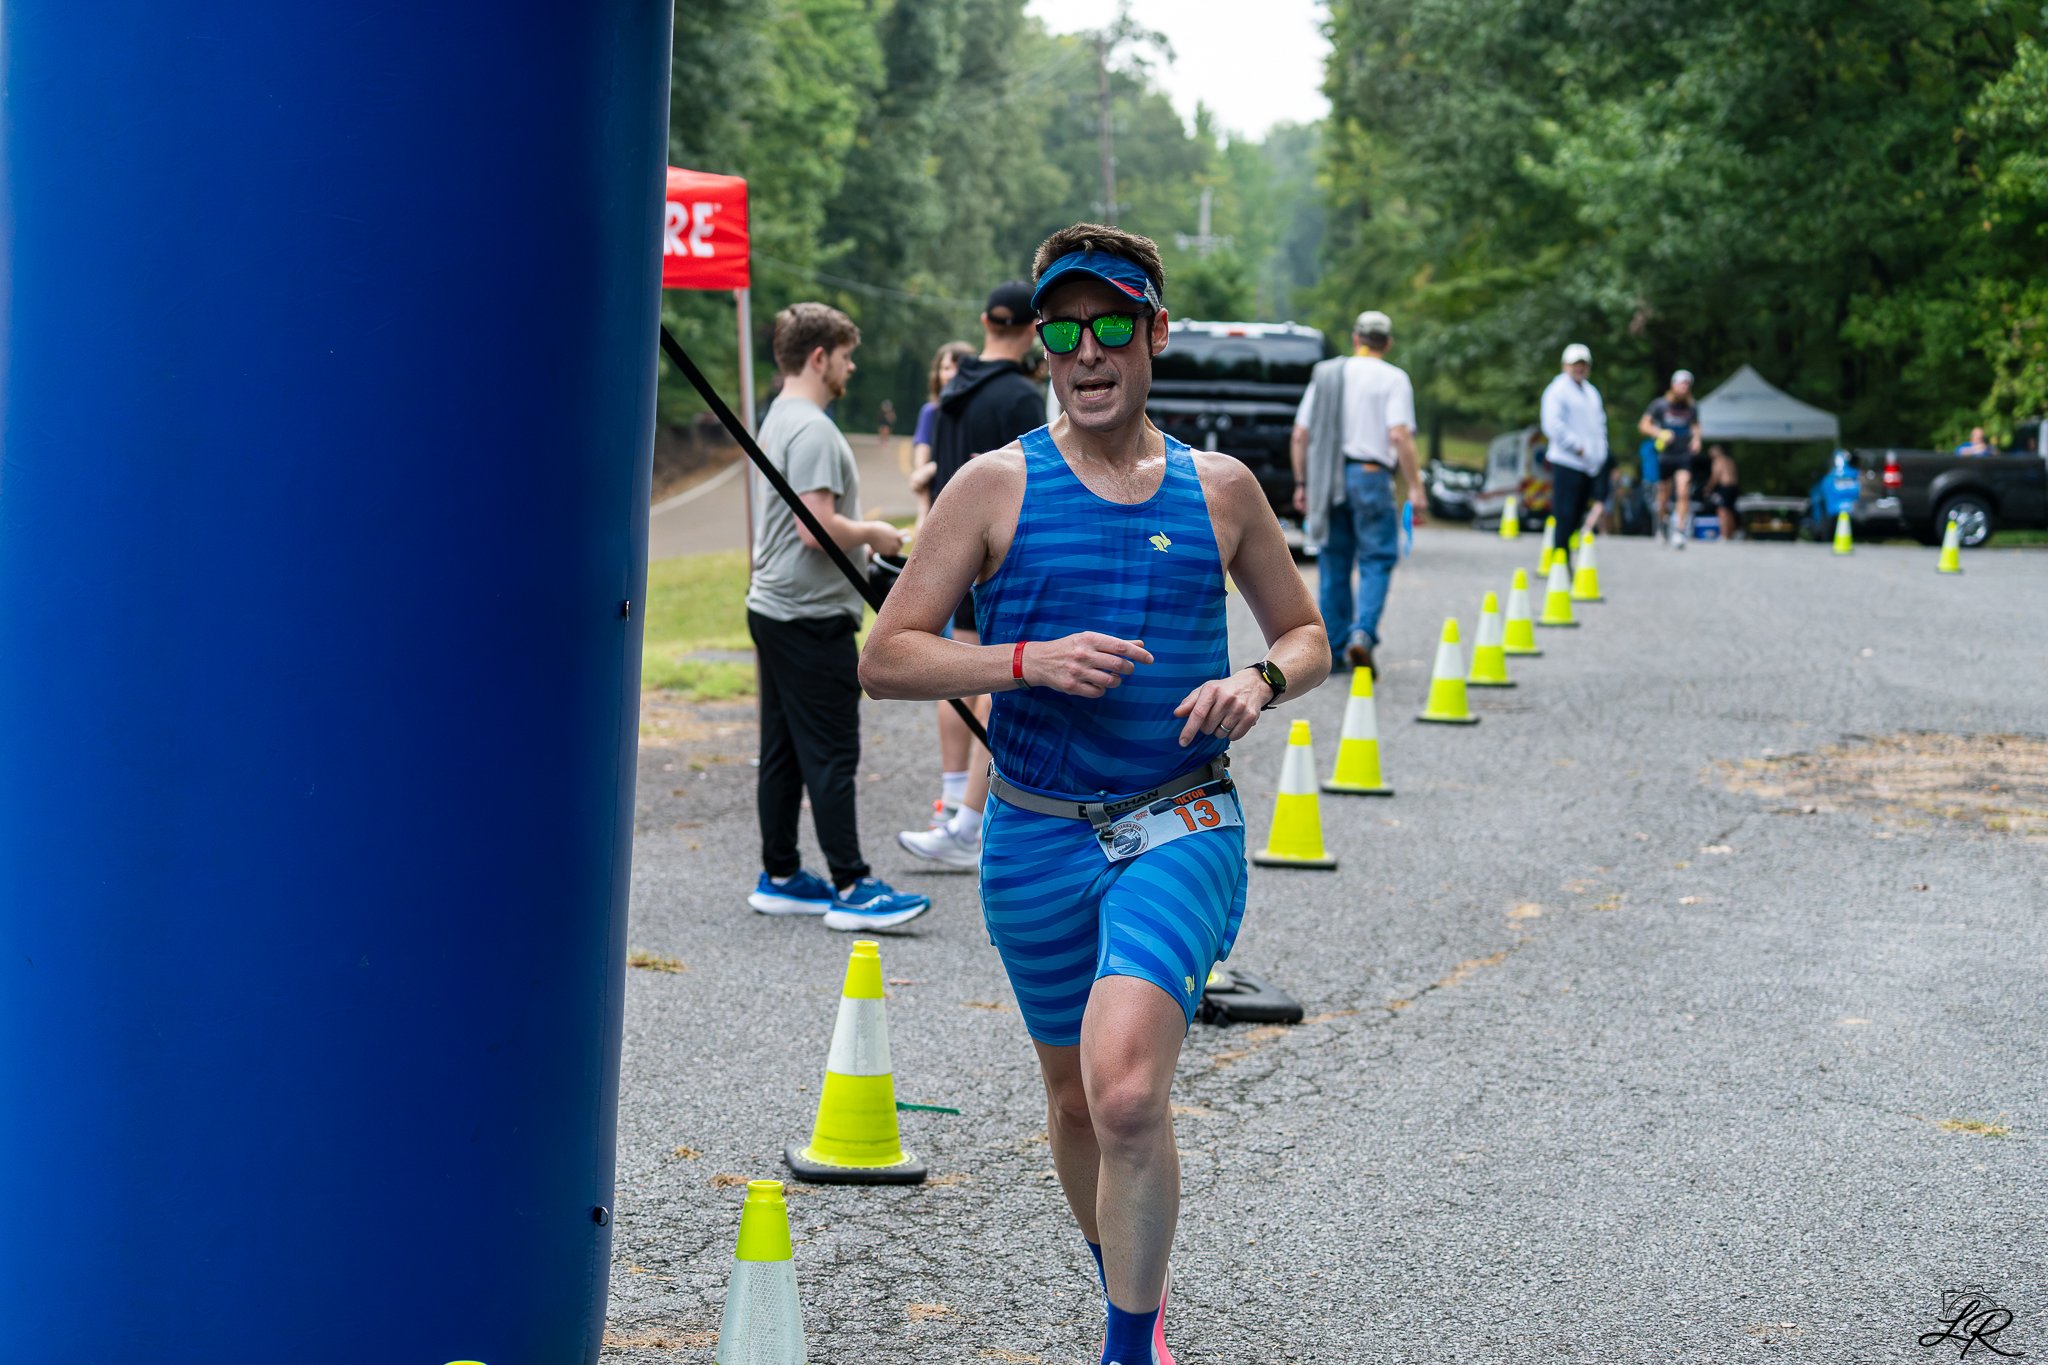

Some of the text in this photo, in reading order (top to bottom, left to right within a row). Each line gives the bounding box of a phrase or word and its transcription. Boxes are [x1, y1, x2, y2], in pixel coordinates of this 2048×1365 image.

[1103, 789, 1159, 812] ATHAN
[1172, 788, 1207, 805] VICTOR
[1173, 799, 1221, 832] 13
